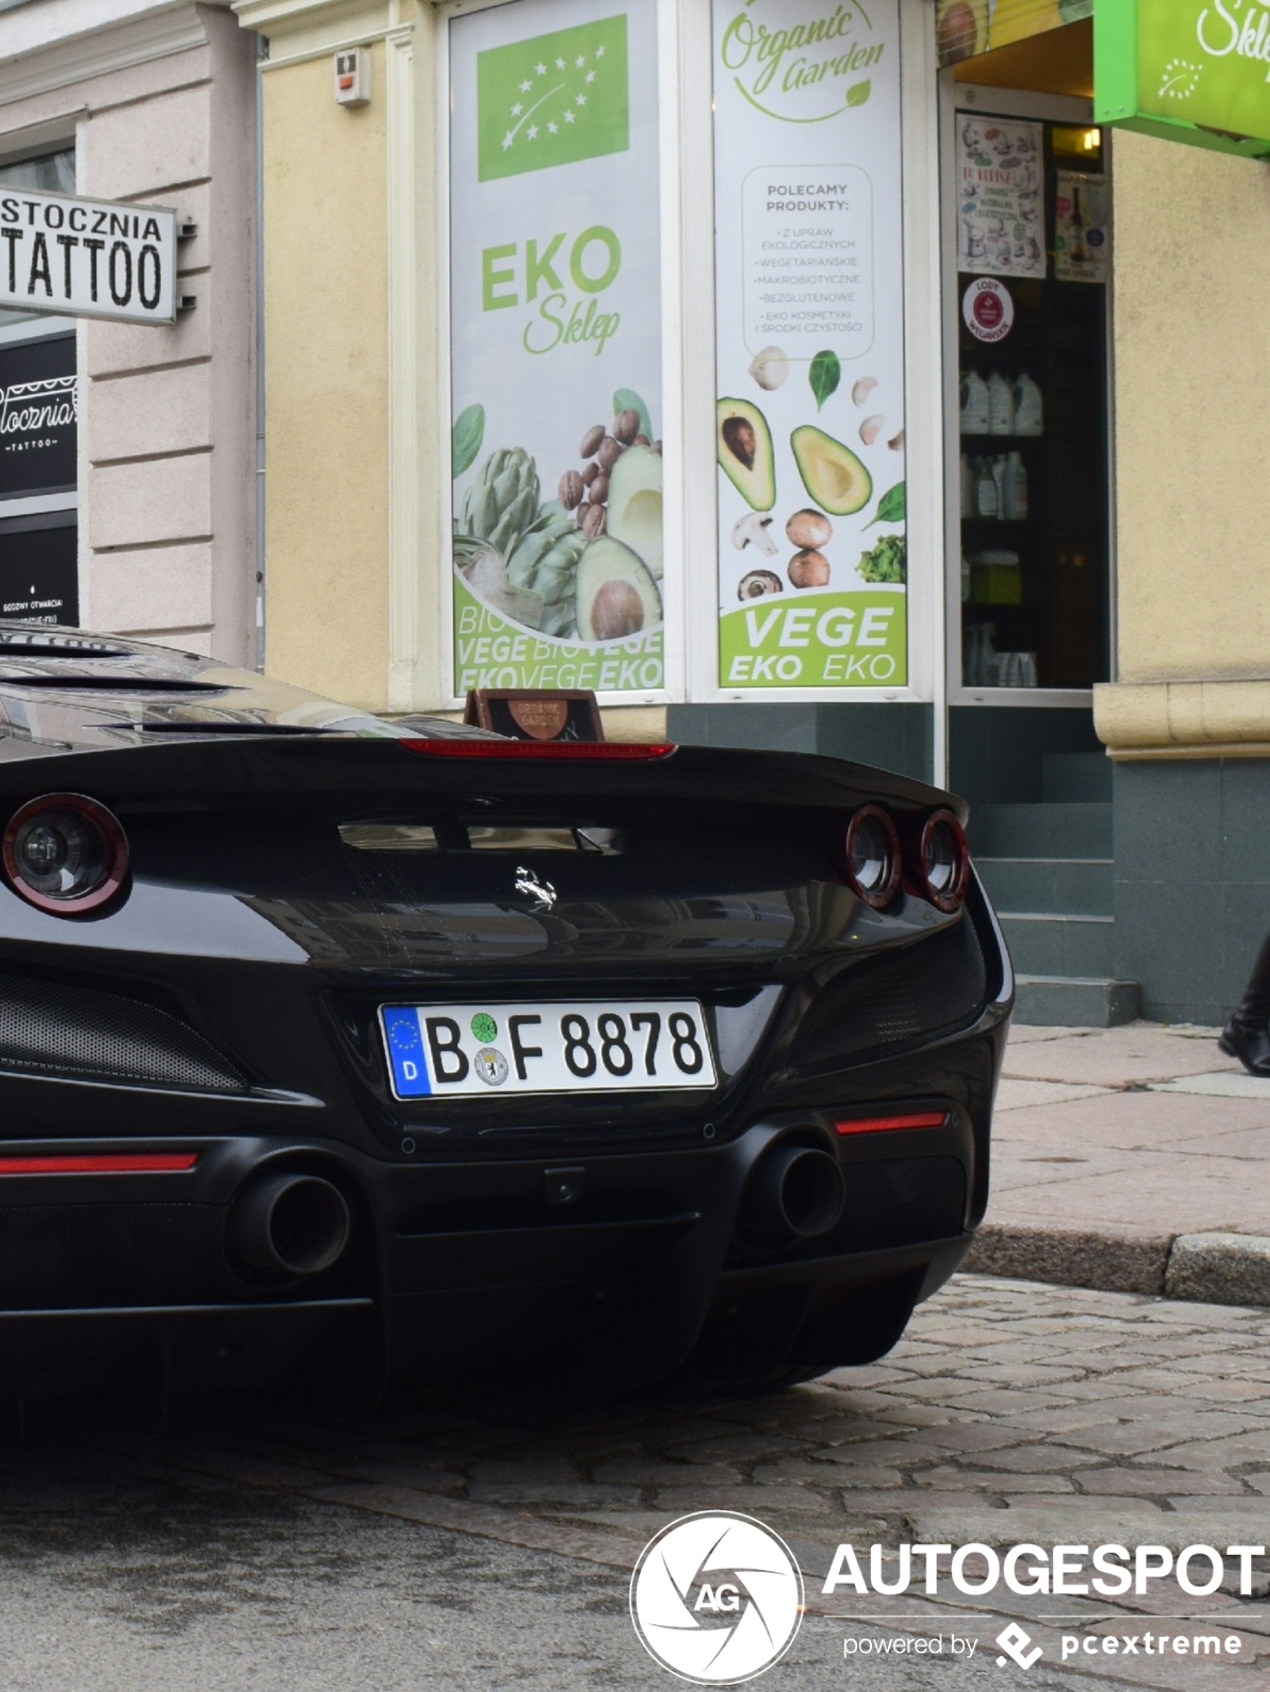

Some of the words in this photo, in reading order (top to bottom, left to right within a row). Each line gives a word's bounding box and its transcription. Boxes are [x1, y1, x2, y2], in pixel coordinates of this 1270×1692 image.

[721, 3, 854, 95] Organic
[782, 42, 885, 93] Garden
[767, 184, 847, 196] POLECAMY
[766, 199, 850, 212] PRODUKTY:
[0, 198, 162, 242] STOCZNIA
[792, 228, 834, 238] UPRAW
[761, 240, 856, 251] EKOLOGICZNYCH
[0, 227, 162, 310] TATTOO
[482, 225, 622, 313] EKO
[763, 292, 855, 303] BEZGLUTENOWE
[976, 281, 999, 291] LODY
[523, 293, 621, 356] Sklep
[766, 311, 789, 321] EKO
[790, 310, 852, 321] KOSMETYKI
[3, 602, 29, 612] GODZINY
[458, 606, 506, 634] BIO
[744, 606, 895, 648] VEGE
[458, 635, 529, 664] VEGE
[459, 666, 518, 697] EKO
[520, 662, 596, 690] VEGE
[598, 657, 664, 691] EKO
[728, 655, 803, 681] EKO
[822, 654, 896, 681] EKO
[521, 714, 560, 726] GARDEN
[425, 1016, 469, 1083] B
[508, 1014, 543, 1080] F
[559, 1011, 703, 1078] 8878
[403, 1061, 418, 1080] D
